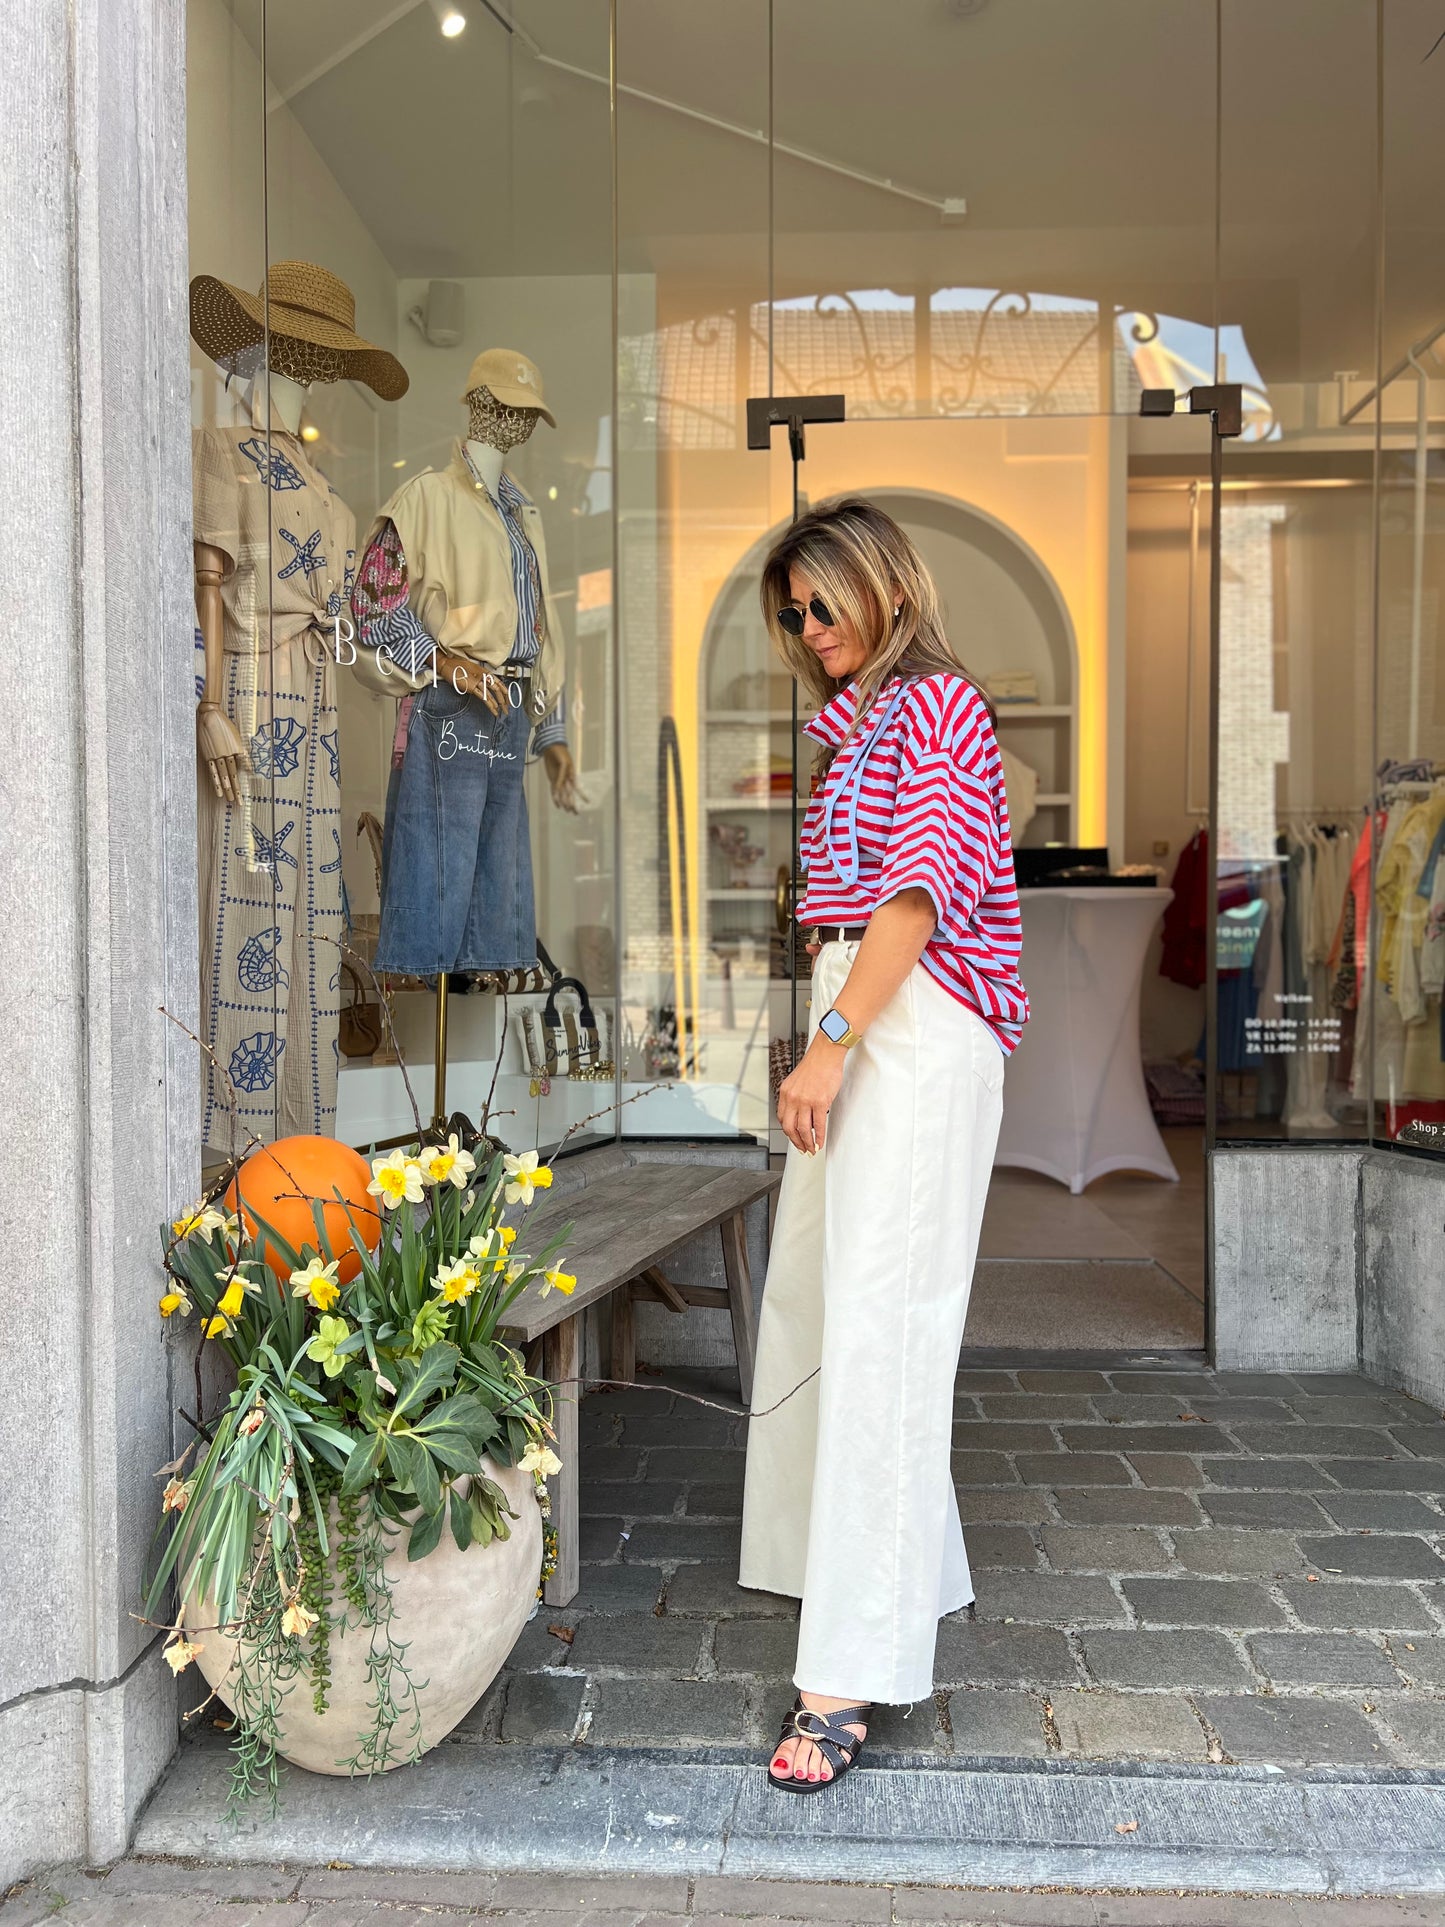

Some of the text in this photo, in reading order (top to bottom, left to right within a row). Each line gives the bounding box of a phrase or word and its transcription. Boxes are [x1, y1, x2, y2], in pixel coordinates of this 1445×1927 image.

[334, 617, 547, 716] Belleros
[438, 720, 517, 768] Boutique
[1412, 1119, 1438, 1136] Shop
